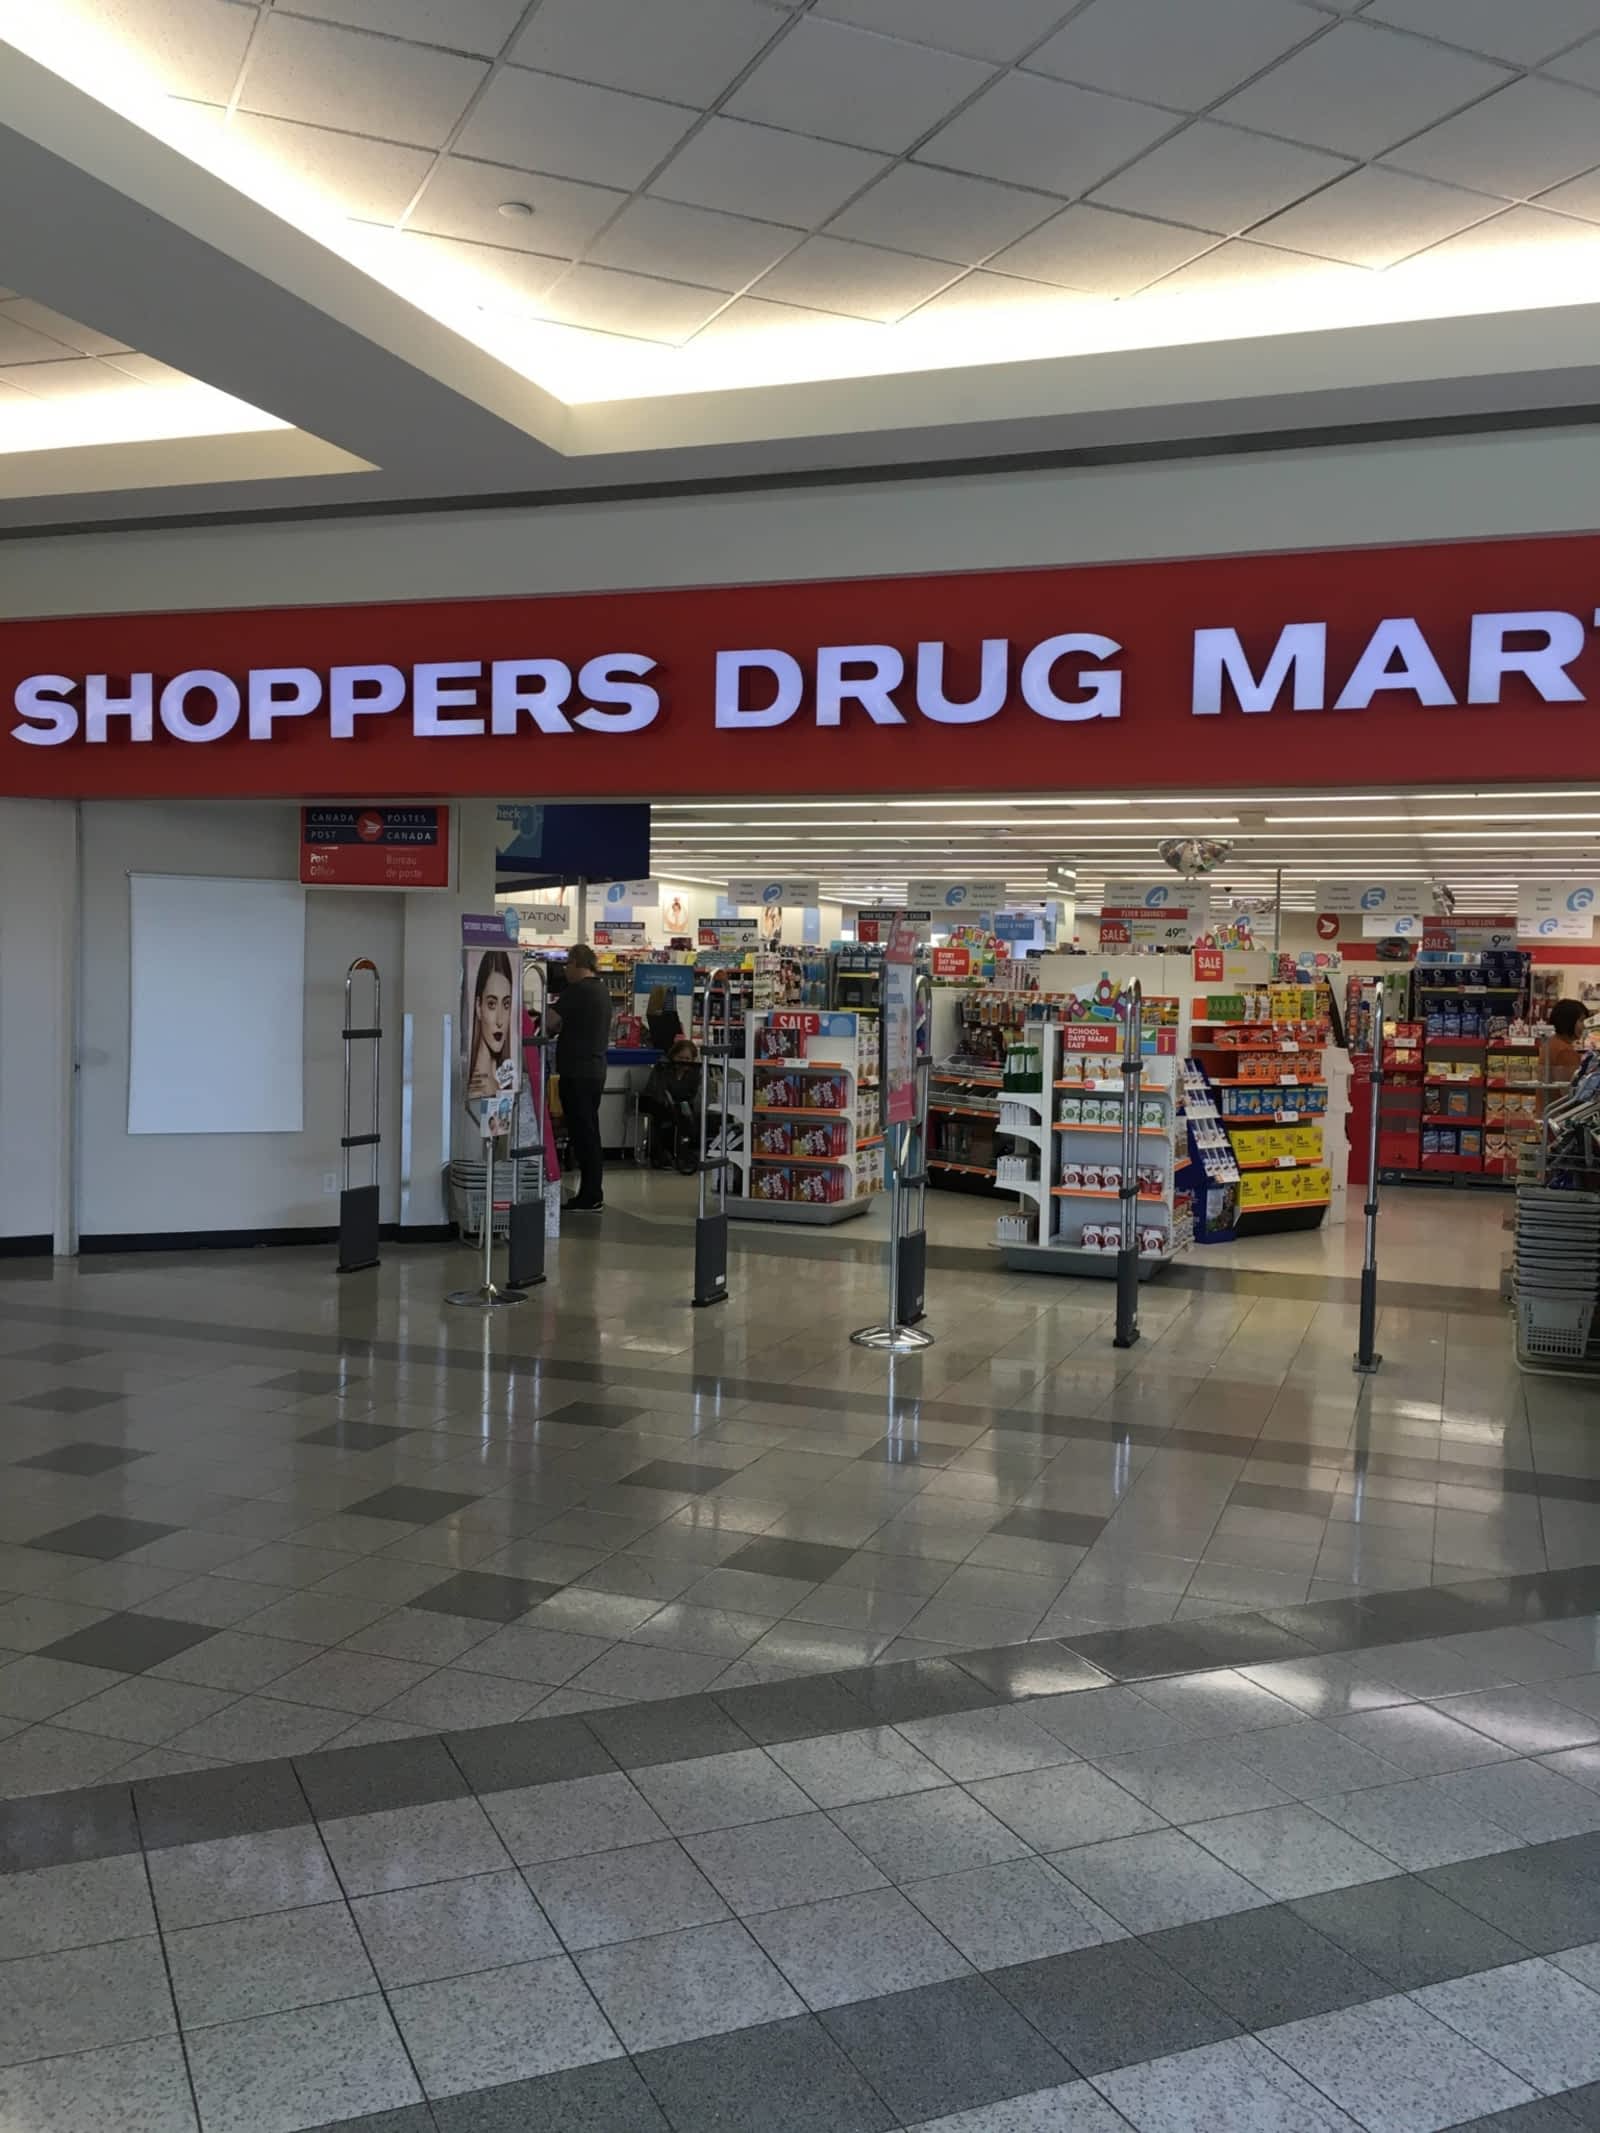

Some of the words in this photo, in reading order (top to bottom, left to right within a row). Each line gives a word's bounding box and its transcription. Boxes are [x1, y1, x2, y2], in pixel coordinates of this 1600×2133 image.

[10, 652, 661, 746] SHOPPERS
[715, 632, 1123, 729] DRUG
[1191, 606, 1600, 716] MAR
[311, 813, 355, 822] CANADA
[387, 814, 427, 823] POSTES
[311, 831, 337, 840] POST
[386, 832, 432, 841] CANADA
[310, 853, 329, 865] Post
[386, 855, 417, 866] Bureau
[767, 886, 781, 902] 2
[951, 888, 965, 905] 3
[1150, 890, 1165, 905] 4
[1367, 890, 1383, 908] 5
[1573, 891, 1590, 909] 6
[1102, 929, 1126, 941] SALE
[1424, 937, 1449, 948] SALE
[1198, 956, 1221, 968] SALE
[780, 1015, 813, 1033] SALE
[1067, 1027, 1100, 1035] SCHOOL
[1087, 1035, 1109, 1043] MADE
